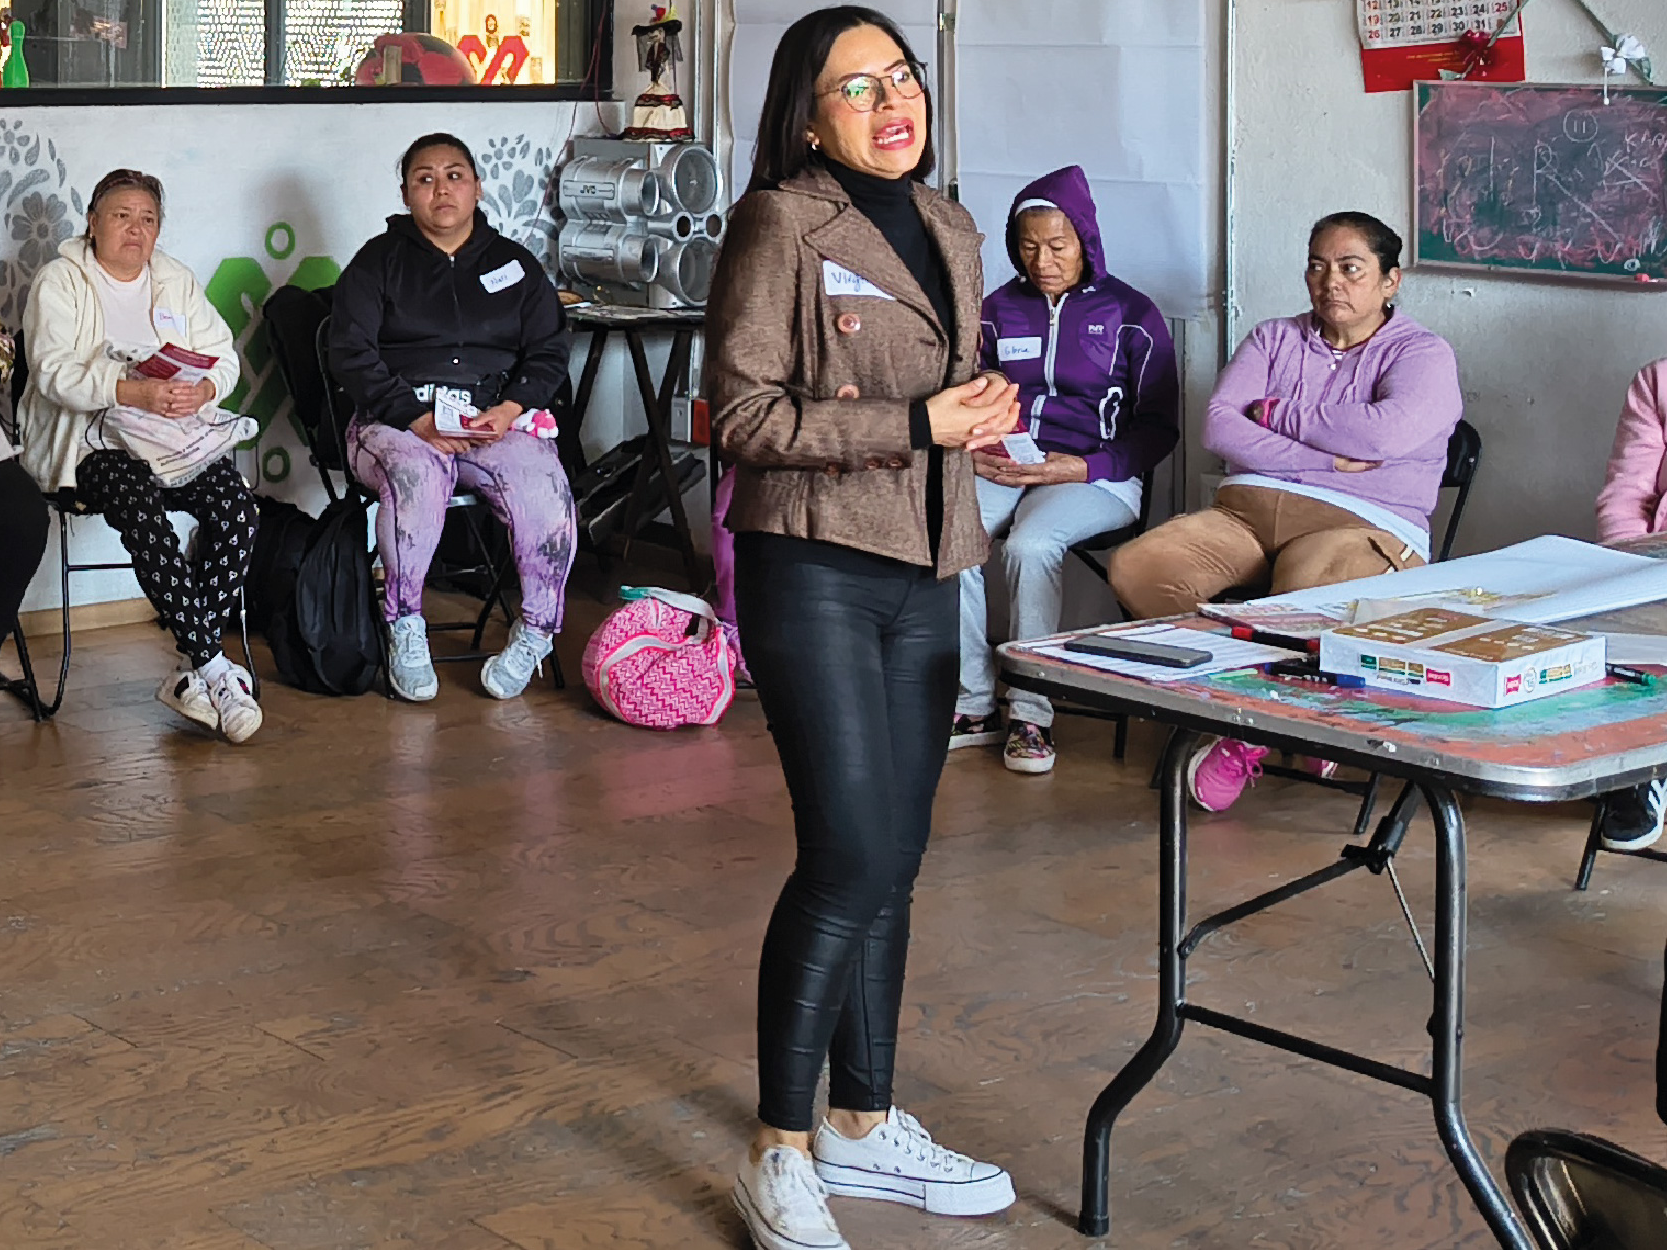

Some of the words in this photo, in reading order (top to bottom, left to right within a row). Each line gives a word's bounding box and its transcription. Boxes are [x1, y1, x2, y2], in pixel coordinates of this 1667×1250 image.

[1409, 10, 1421, 21] 21
[1430, 9, 1443, 19] 22
[1451, 7, 1464, 16] 23
[1473, 4, 1485, 14] 24
[1494, 2, 1508, 12] 25
[1368, 30, 1381, 39] 26
[1389, 27, 1401, 38] 27
[1410, 24, 1422, 35] 28
[1431, 23, 1444, 33] 29
[1452, 21, 1465, 31] 30
[1475, 19, 1486, 28] 31
